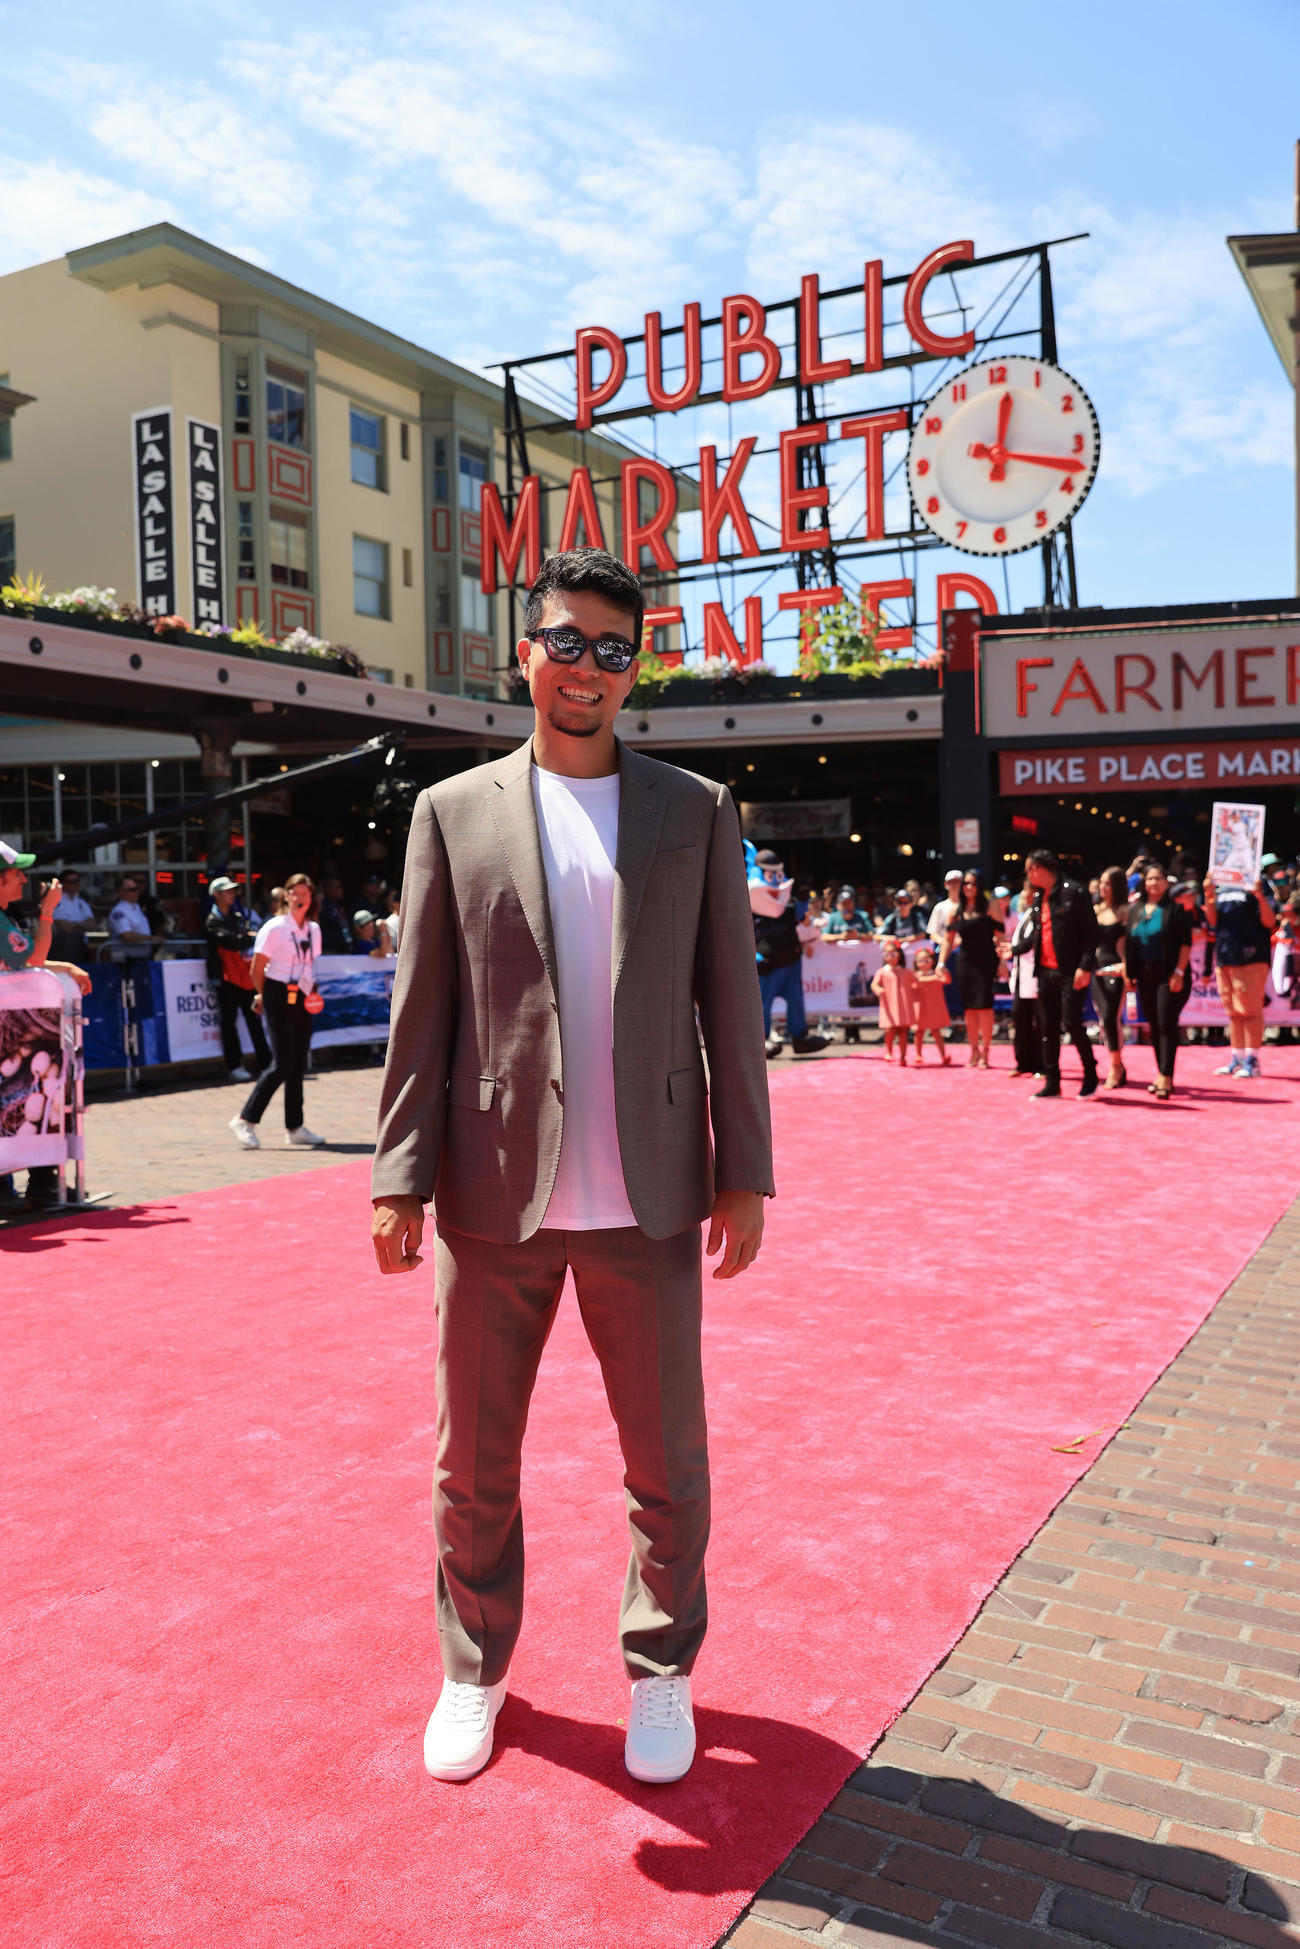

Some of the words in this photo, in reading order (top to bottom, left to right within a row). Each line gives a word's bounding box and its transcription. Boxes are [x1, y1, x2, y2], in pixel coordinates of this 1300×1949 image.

[576, 240, 976, 431] PUBLIC
[988, 366, 1007, 386] 12
[1034, 371, 1041, 389] 1
[952, 383, 967, 404] 11
[1061, 395, 1074, 413] 2
[925, 417, 942, 435] 10
[142, 422, 164, 465] LA
[193, 426, 215, 472] LA
[1072, 434, 1084, 454] 3
[917, 458, 929, 476] 9
[1060, 476, 1074, 495] 4
[480, 410, 908, 594] MARKET
[927, 496, 940, 515] 8
[142, 471, 167, 582] SALLE
[1035, 510, 1047, 528] 5
[195, 481, 217, 588] SALLE
[956, 521, 968, 539] 7
[993, 526, 1007, 544] 6
[1014, 757, 1086, 786] PIKE
[1099, 752, 1206, 783] PLACE
